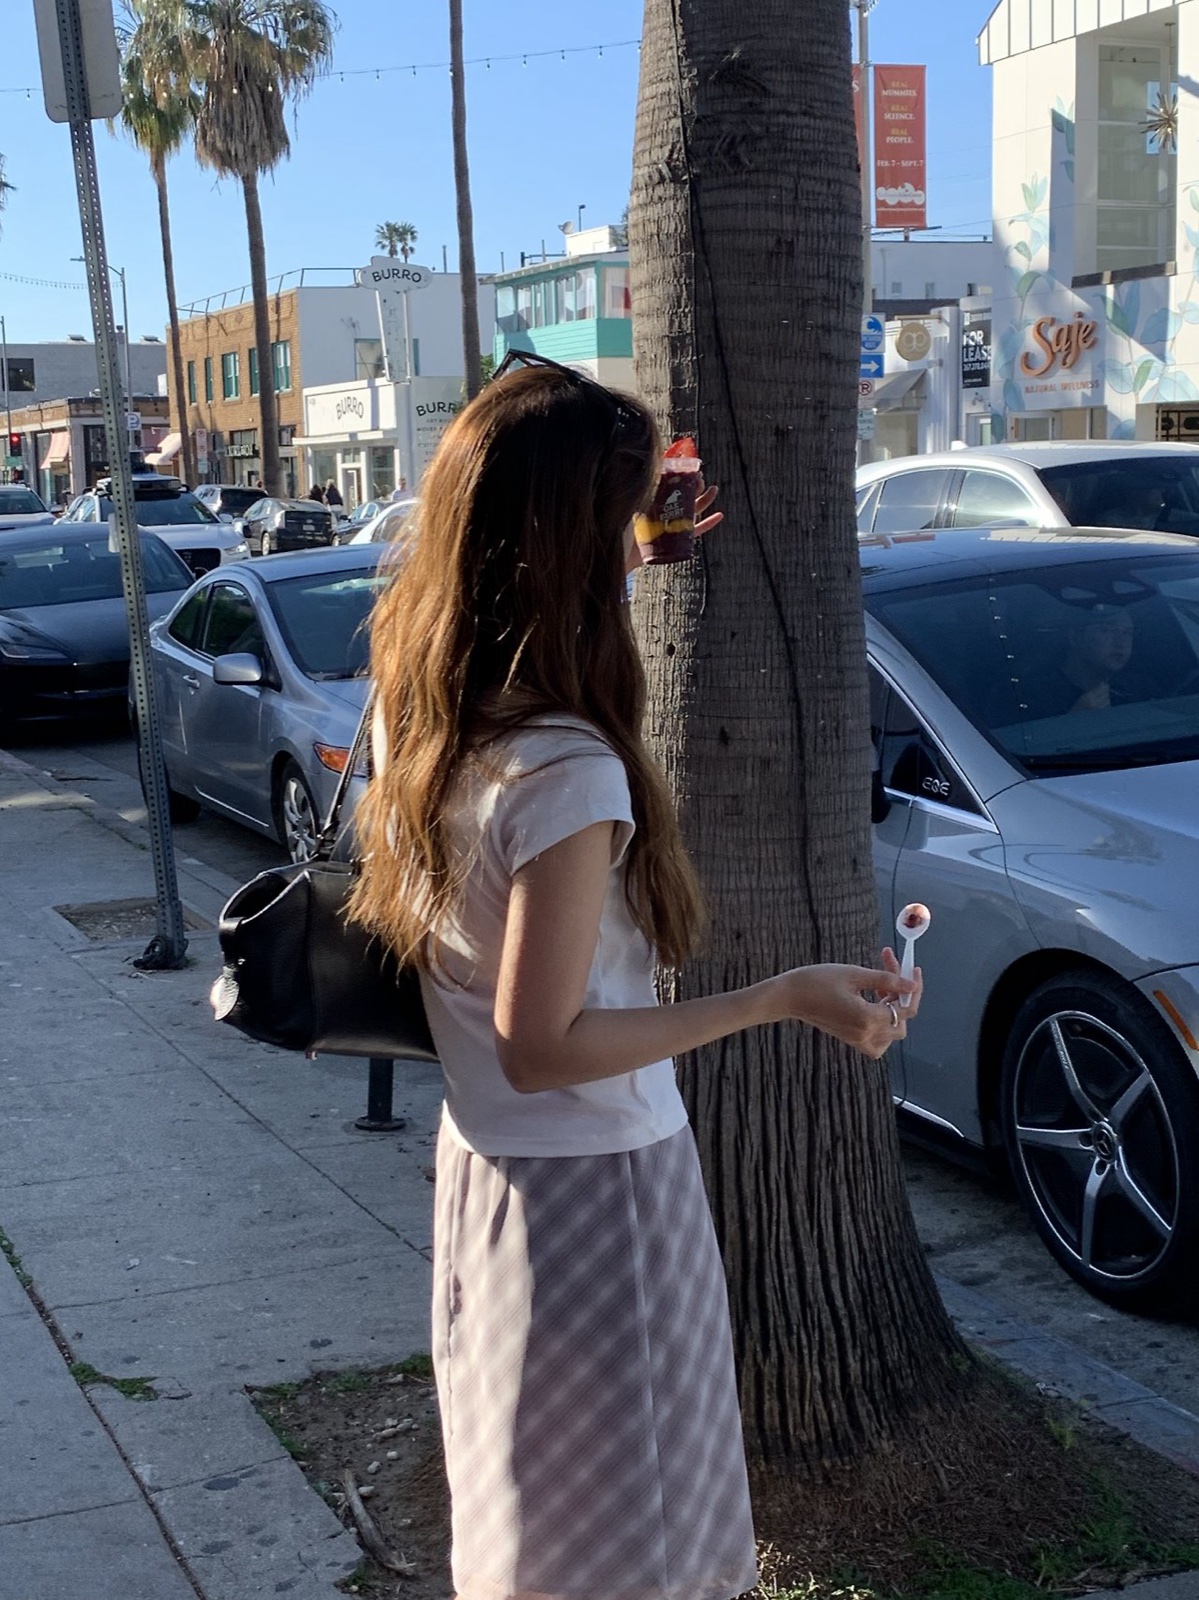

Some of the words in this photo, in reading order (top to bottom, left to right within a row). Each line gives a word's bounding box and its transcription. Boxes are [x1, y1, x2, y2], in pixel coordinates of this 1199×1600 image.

[371, 267, 423, 282] BURRO
[963, 330, 985, 346] FOR
[1021, 311, 1098, 376] Saje
[963, 345, 992, 362] LEASE
[1024, 384, 1057, 393] NATURAL
[1060, 379, 1099, 391] WELLNESS
[336, 396, 365, 420] BURRO
[416, 401, 458, 417] BURR
[922, 776, 950, 796] EQE
